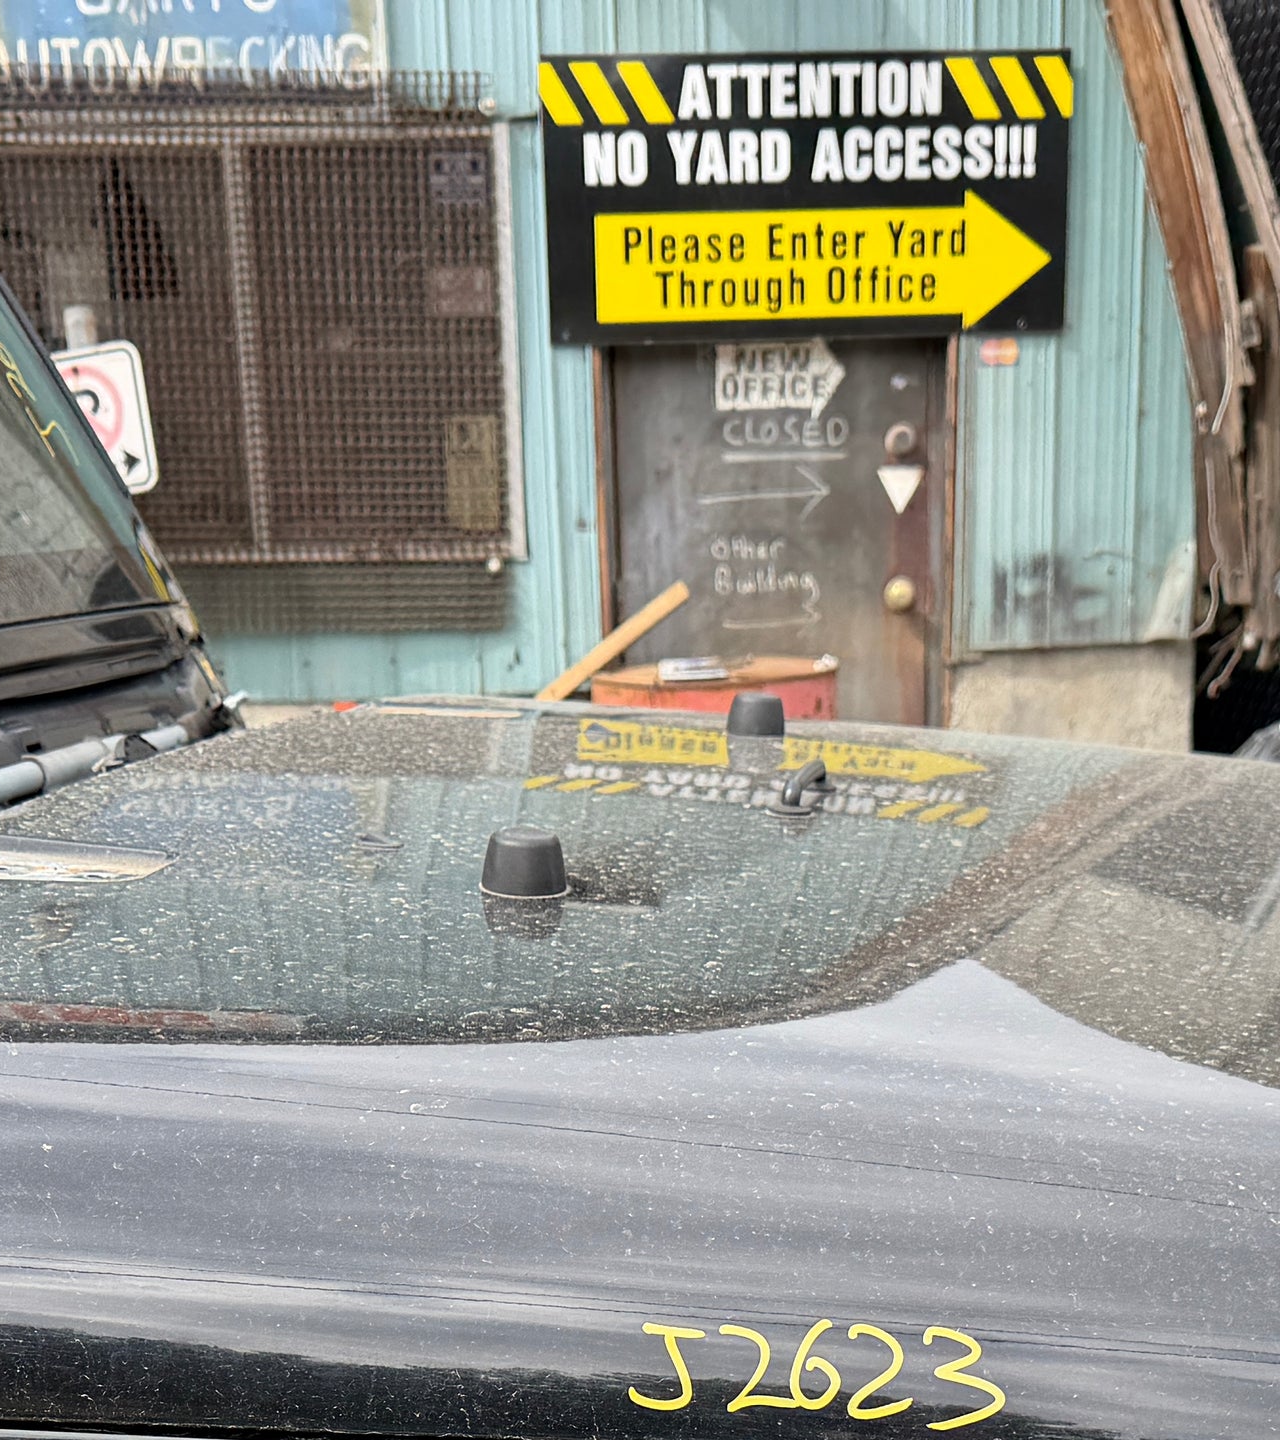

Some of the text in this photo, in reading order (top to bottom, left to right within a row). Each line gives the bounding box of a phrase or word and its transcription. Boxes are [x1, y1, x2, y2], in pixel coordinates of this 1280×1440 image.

[677, 60, 942, 122] ATTENTION
[582, 124, 1037, 187] NO YARD ACCESS!!!
[623, 218, 967, 266] Please Enter Yard
[654, 265, 937, 314] Through Office
[735, 348, 811, 373] NEW
[722, 373, 828, 400] OFFICE
[723, 415, 849, 447] CLOSED
[628, 1318, 1007, 1431] J2623
